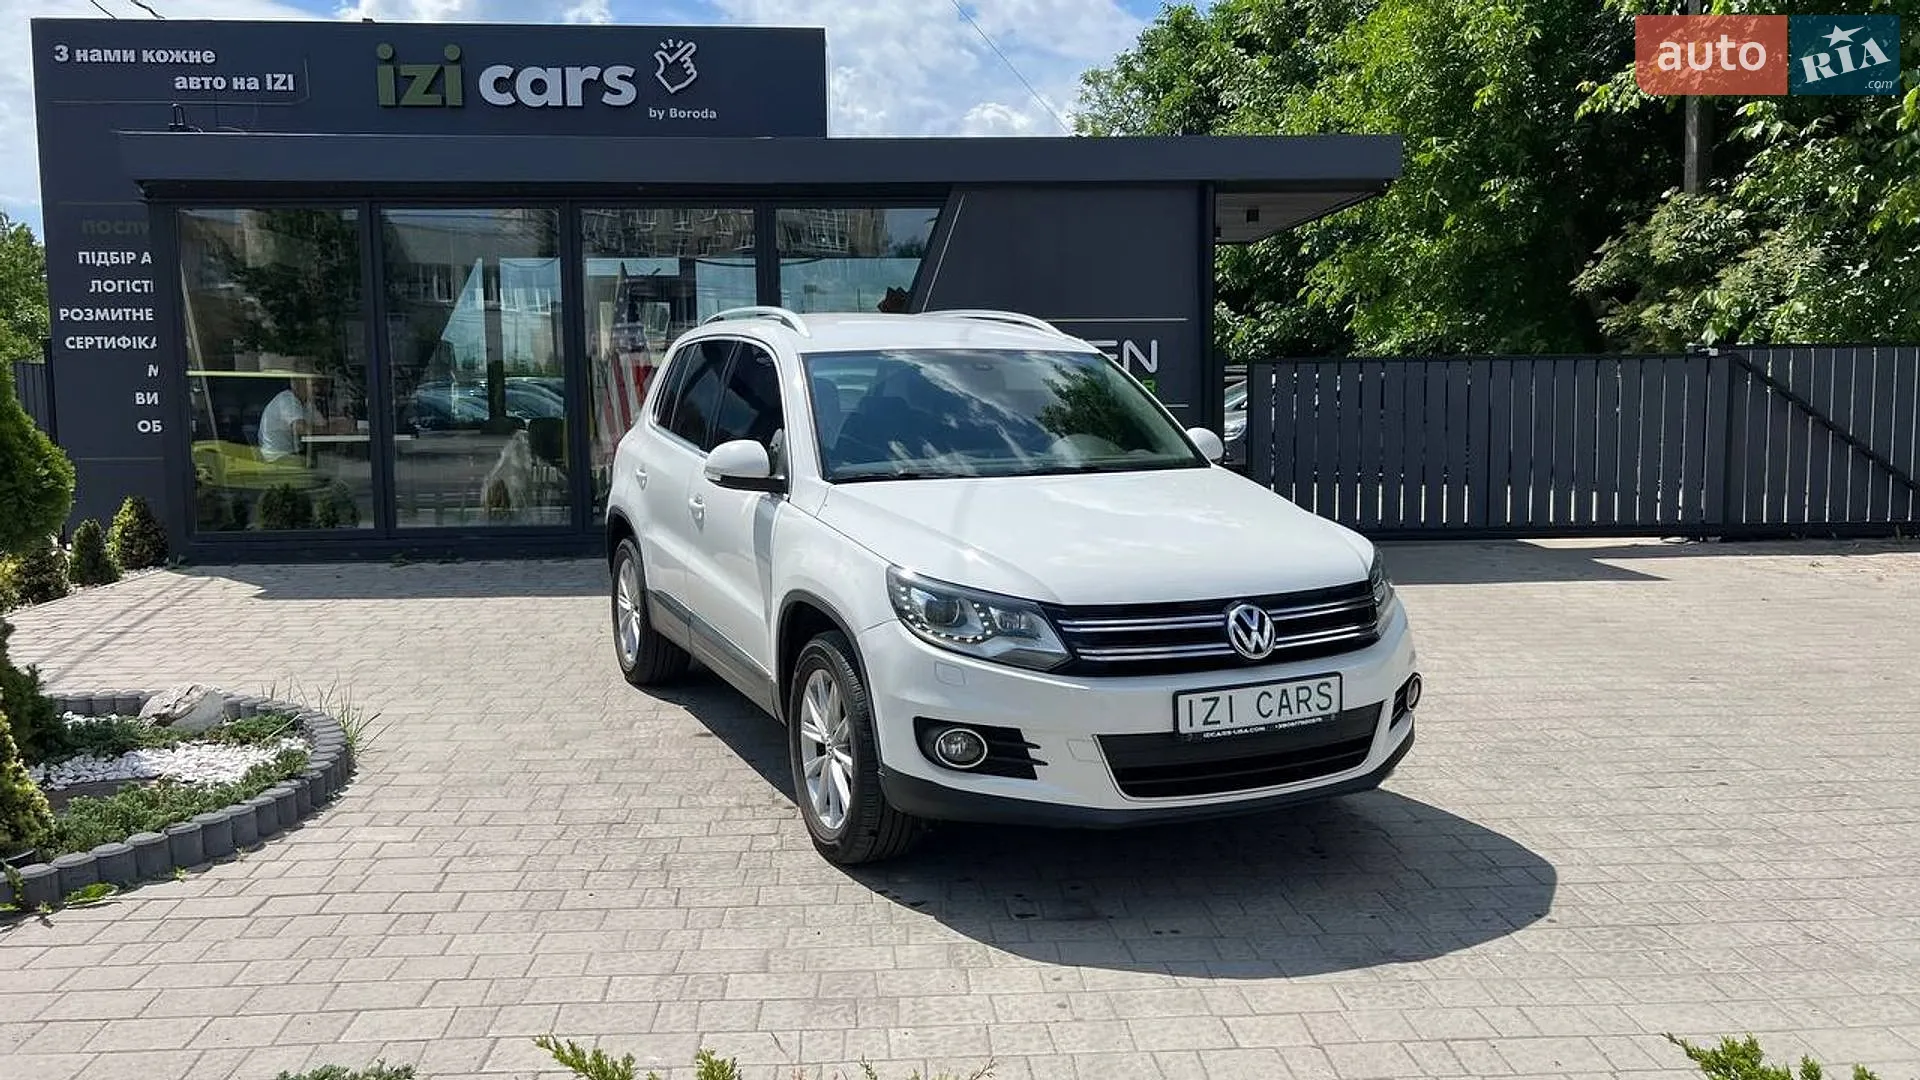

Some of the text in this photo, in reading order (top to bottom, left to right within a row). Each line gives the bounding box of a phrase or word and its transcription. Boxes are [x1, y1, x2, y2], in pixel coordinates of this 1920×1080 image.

[75, 48, 135, 63] нами
[142, 48, 216, 64] кожне
[174, 73, 295, 91] авто на IZI
[376, 43, 638, 107] izi cars
[649, 108, 717, 120] by Boroda
[78, 252, 136, 267] ПІДБІР
[89, 280, 154, 293] ЛОГІСТ
[59, 308, 154, 321] РОЗМИТНЕ
[137, 420, 162, 432] ОБ
[1188, 682, 1333, 728] IZI CARS
